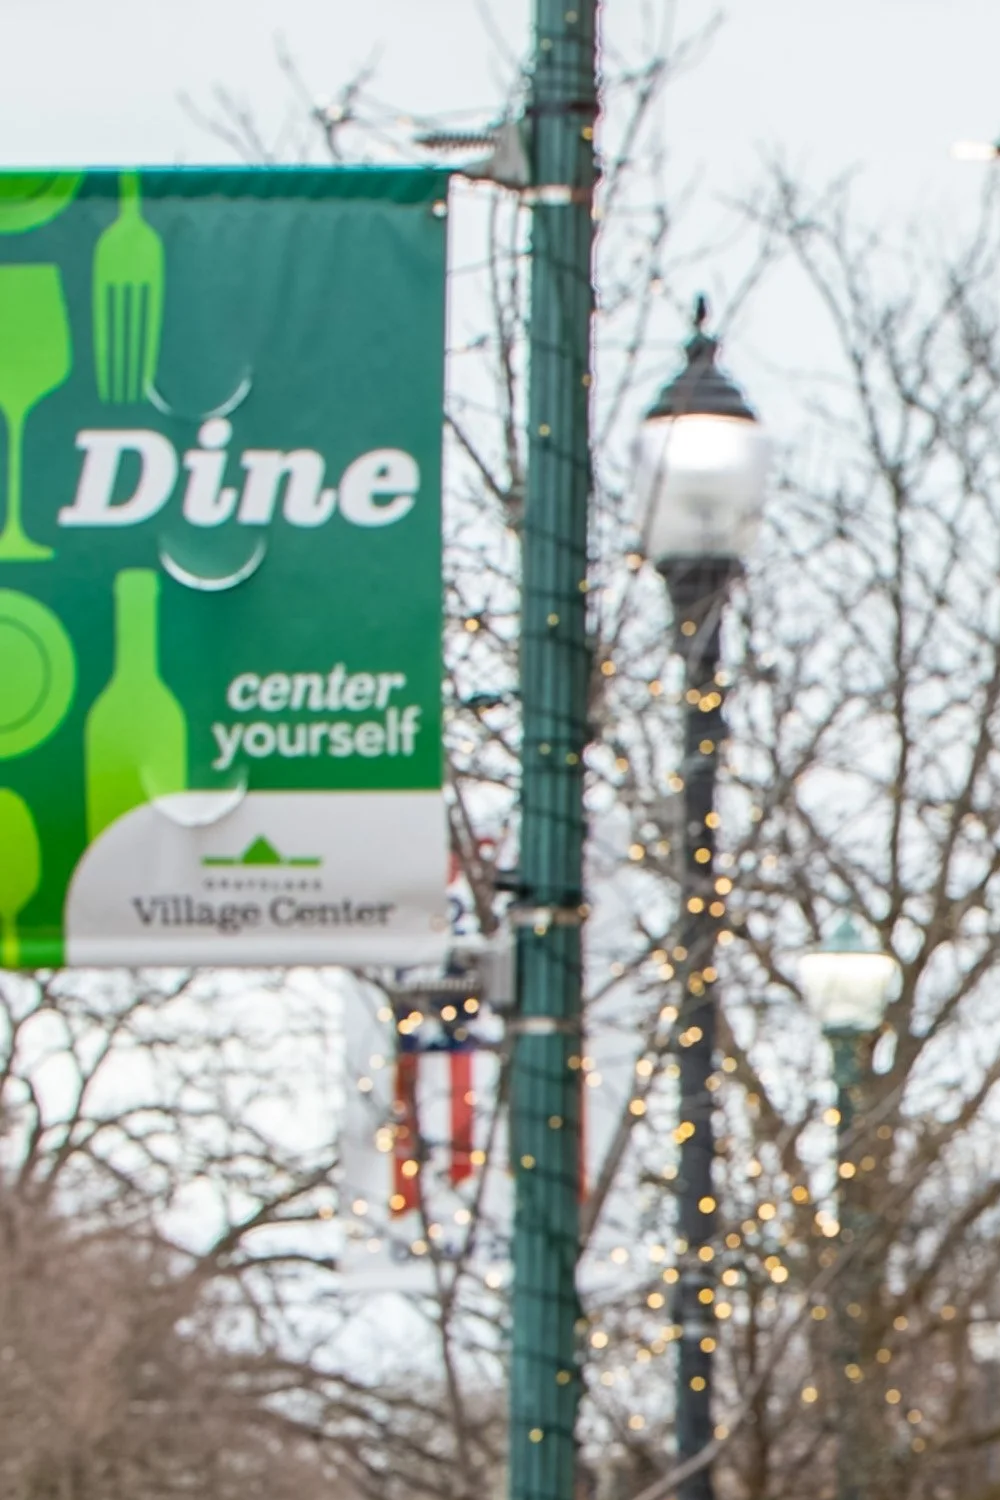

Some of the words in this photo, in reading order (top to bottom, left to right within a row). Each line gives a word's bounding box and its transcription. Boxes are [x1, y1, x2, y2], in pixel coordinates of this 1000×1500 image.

[58, 418, 420, 527] Dine
[227, 662, 406, 711] center
[212, 705, 422, 770] yourself
[132, 895, 262, 935] Village
[269, 896, 395, 927] Center
